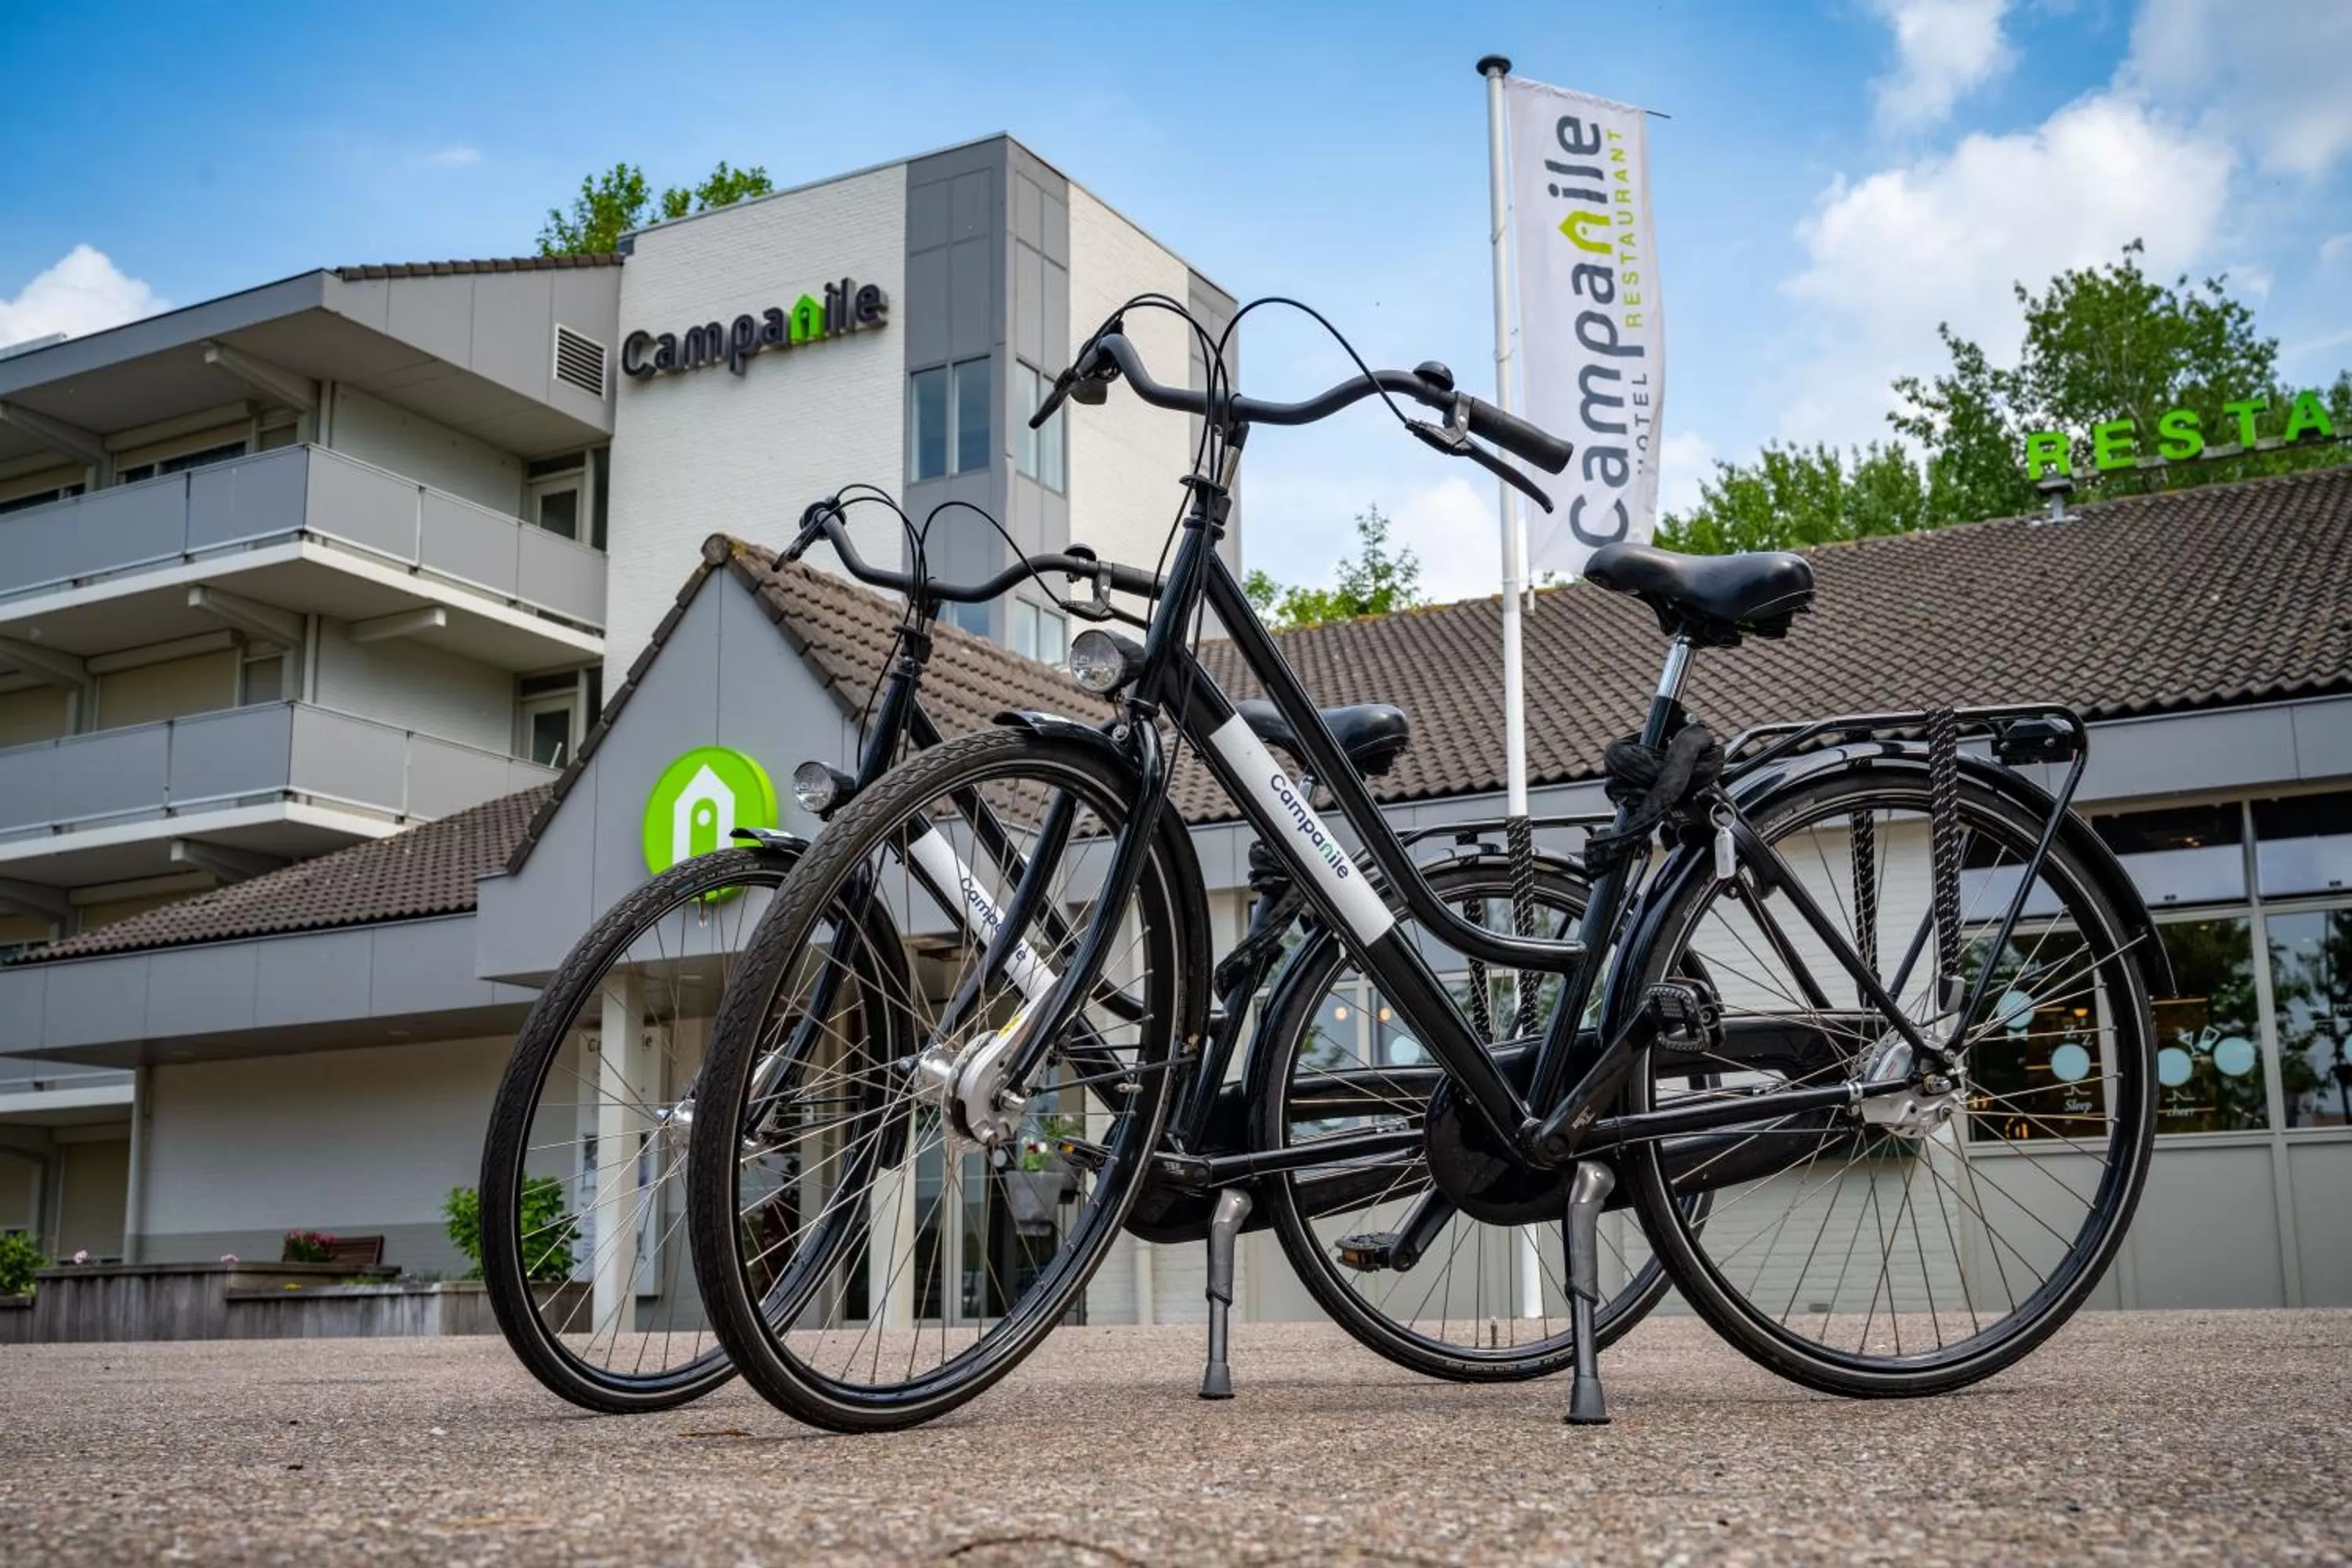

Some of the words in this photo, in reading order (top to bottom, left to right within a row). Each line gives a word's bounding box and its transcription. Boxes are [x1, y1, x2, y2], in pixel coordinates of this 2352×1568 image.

[1606, 129, 1642, 328] RESTAURANT
[622, 277, 887, 379] Campanile
[1544, 114, 1645, 547] Campanile
[1632, 373, 1650, 474] OTEL
[2026, 390, 2334, 481] RESTA
[1270, 773, 1349, 879] Campanile
[2064, 1098, 2093, 1114] Sleep
